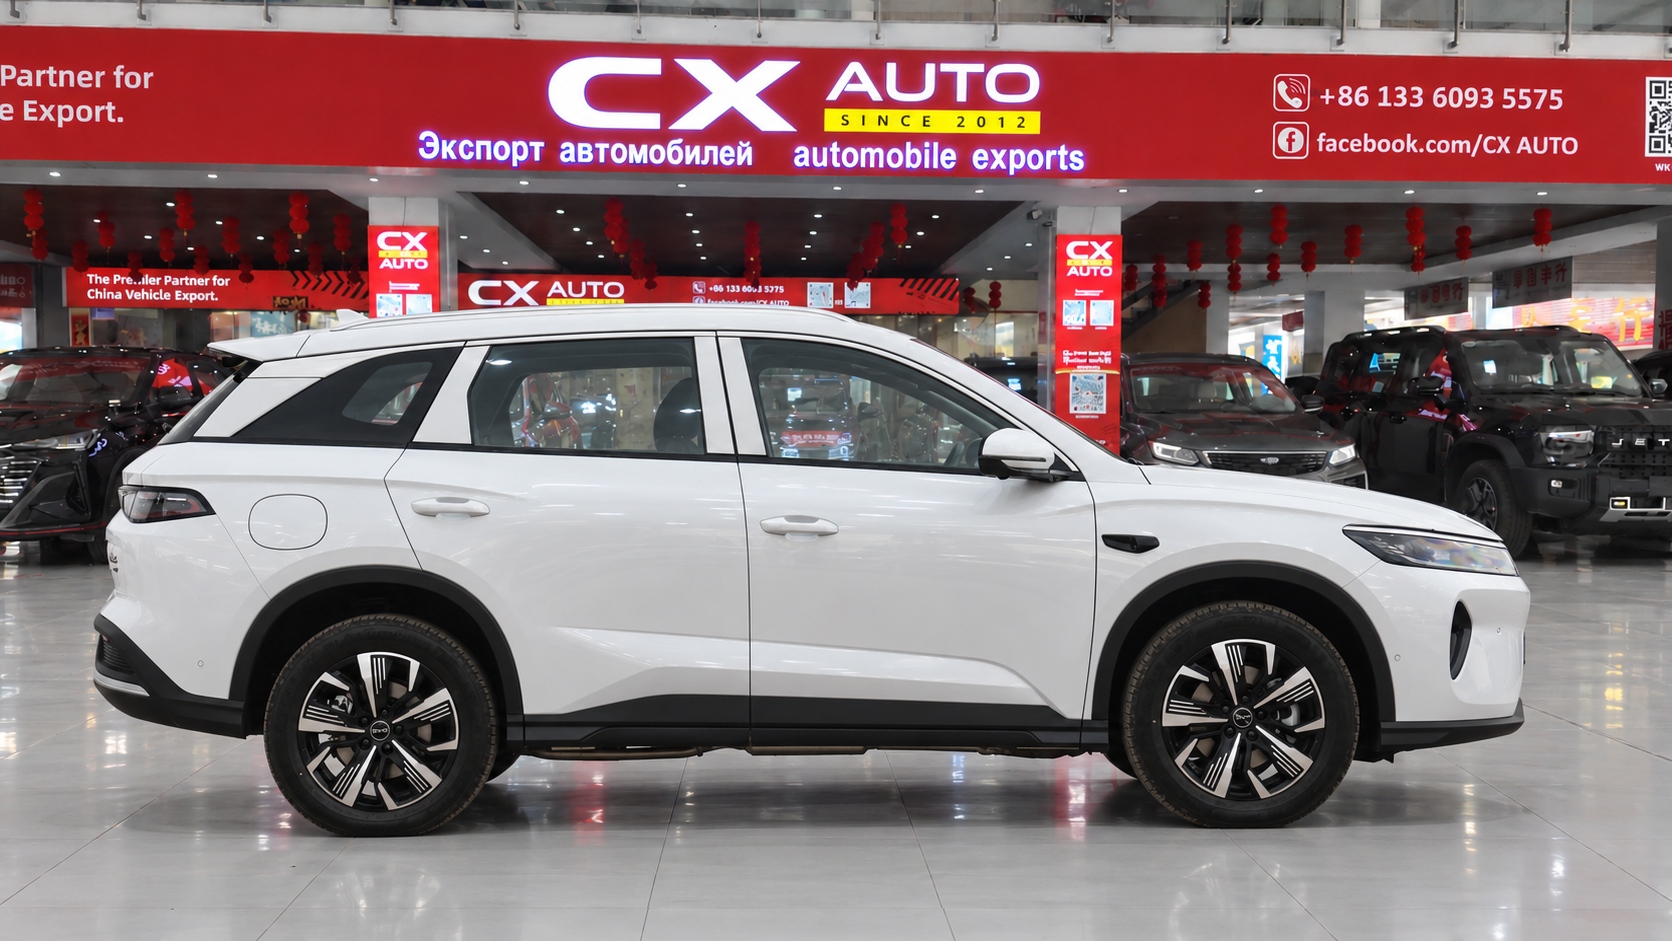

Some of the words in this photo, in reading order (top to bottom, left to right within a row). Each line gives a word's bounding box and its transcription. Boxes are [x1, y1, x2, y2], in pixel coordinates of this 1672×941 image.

[1, 65, 105, 88] Partner
[113, 65, 154, 89] for
[826, 62, 1040, 103] AUTO
[548, 57, 799, 131] CX
[1320, 86, 1369, 107] +86
[1378, 86, 1424, 107] 133
[1432, 87, 1494, 109] 6093
[1502, 88, 1563, 109] 5575
[23, 100, 124, 127] Export.
[841, 114, 931, 127] SINCE
[957, 116, 1026, 129] 2012
[418, 130, 545, 167] Экспорт
[560, 138, 753, 166] автомобилей
[1317, 133, 1511, 157] facebook.com/CX
[1517, 137, 1579, 154] AUTO
[794, 142, 957, 169] automobile
[972, 145, 1085, 175] exports
[377, 231, 427, 251] CX
[1066, 241, 1113, 260] CX
[379, 258, 428, 269] AUTO
[1067, 266, 1113, 276] AUTO
[87, 274, 110, 285] The
[164, 275, 210, 287] Partner
[212, 275, 231, 287] for
[547, 281, 625, 298] AUTO
[726, 285, 740, 293] 133
[87, 288, 122, 299] China
[125, 289, 171, 300] Vehicle
[175, 291, 219, 303] Export.
[468, 280, 539, 306] CX
